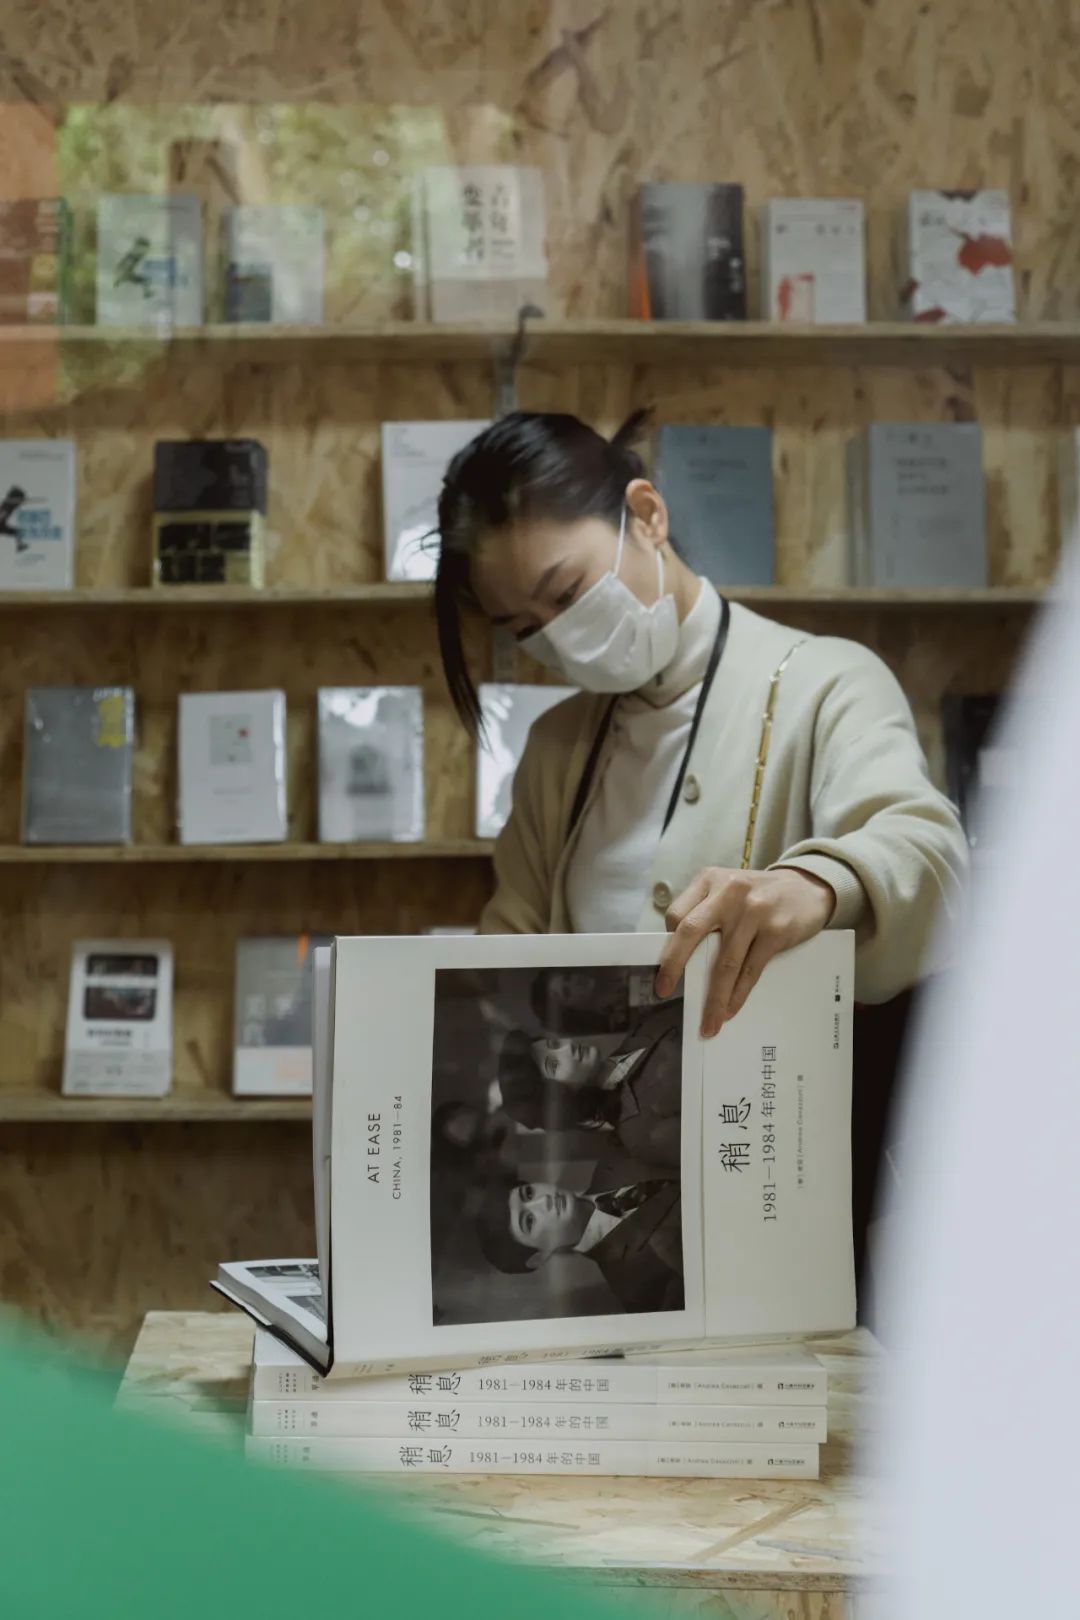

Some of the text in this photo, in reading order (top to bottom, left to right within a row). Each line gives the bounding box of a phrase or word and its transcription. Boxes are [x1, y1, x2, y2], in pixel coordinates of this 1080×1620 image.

[761, 1045, 778, 1118] 年的中国
[367, 1112, 381, 1185] AT EASE
[718, 1096, 752, 1173] 稍息
[392, 1156, 403, 1200] CHINA,
[408, 1372, 462, 1396] 稍息
[555, 1378, 610, 1392] 年的中国
[406, 1409, 461, 1432] 稍息
[554, 1415, 610, 1430] 年的中国
[398, 1444, 453, 1467] 稍息
[546, 1451, 601, 1466] 年的中国
